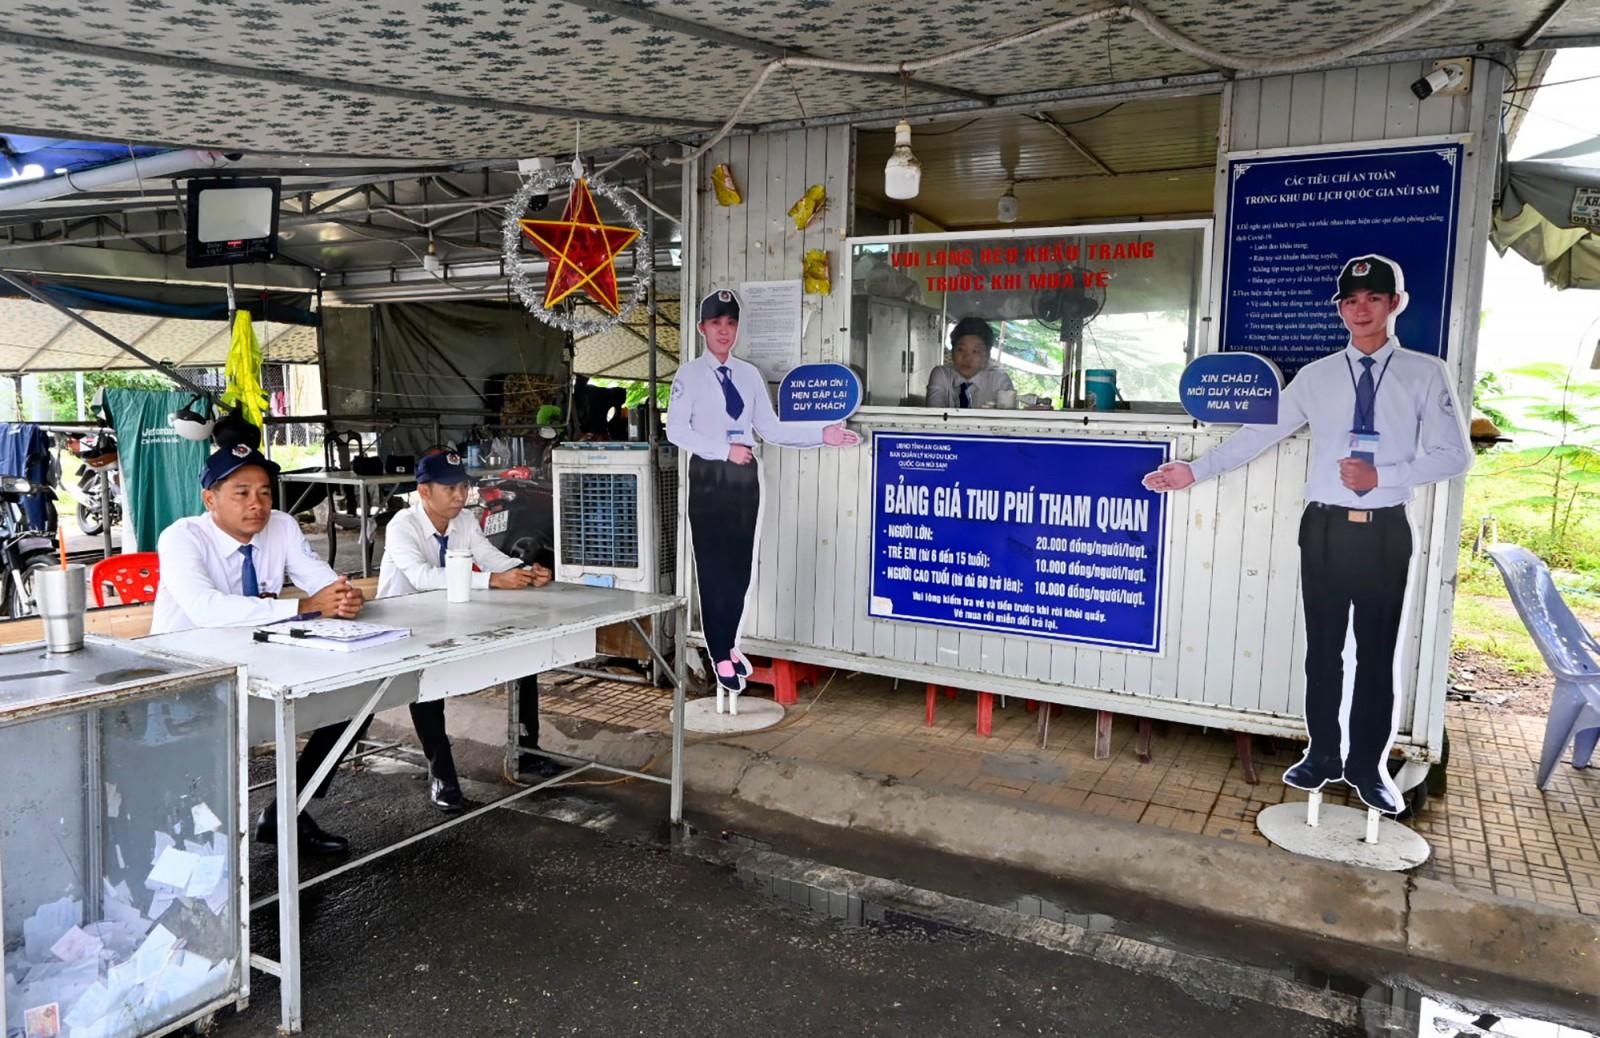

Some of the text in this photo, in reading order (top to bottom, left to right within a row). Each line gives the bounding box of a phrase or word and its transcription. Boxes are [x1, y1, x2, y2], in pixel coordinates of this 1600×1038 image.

[1352, 173, 1366, 181] AN
[1245, 195, 1277, 205] TRONG
[1280, 194, 1300, 203] KHU
[1302, 193, 1316, 201] DU
[1318, 191, 1342, 202] LỊCH
[1376, 188, 1394, 197] GIA
[1396, 184, 1414, 196] NÚI
[1417, 185, 1440, 195] SAM
[892, 252, 920, 267] VUI
[1088, 241, 1155, 260] TRANG
[991, 273, 1023, 290] KHI
[1029, 271, 1074, 289] MUA
[790, 380, 805, 388] XIN
[1201, 374, 1219, 383] XIN
[1234, 386, 1272, 396] KHÁCH
[815, 402, 846, 410] KHÁCH
[1207, 401, 1230, 409] MUA
[885, 475, 1149, 532] BẢNG GIÁ THU PHÍ THAM QUAN
[1036, 537, 1067, 552] 20.000
[888, 542, 902, 559] TRẺ
[904, 547, 916, 560] EM
[931, 550, 936, 562] 6
[956, 552, 966, 565] 15
[1036, 559, 1066, 574] 10.000
[914, 569, 929, 582] CAO
[932, 567, 949, 584] TUỔI
[977, 575, 987, 589] 60
[1035, 581, 1065, 597] 10.000
[912, 592, 923, 601] Vui
[964, 597, 974, 607] tra
[1037, 603, 1049, 615] khi
[965, 611, 981, 620] mua
